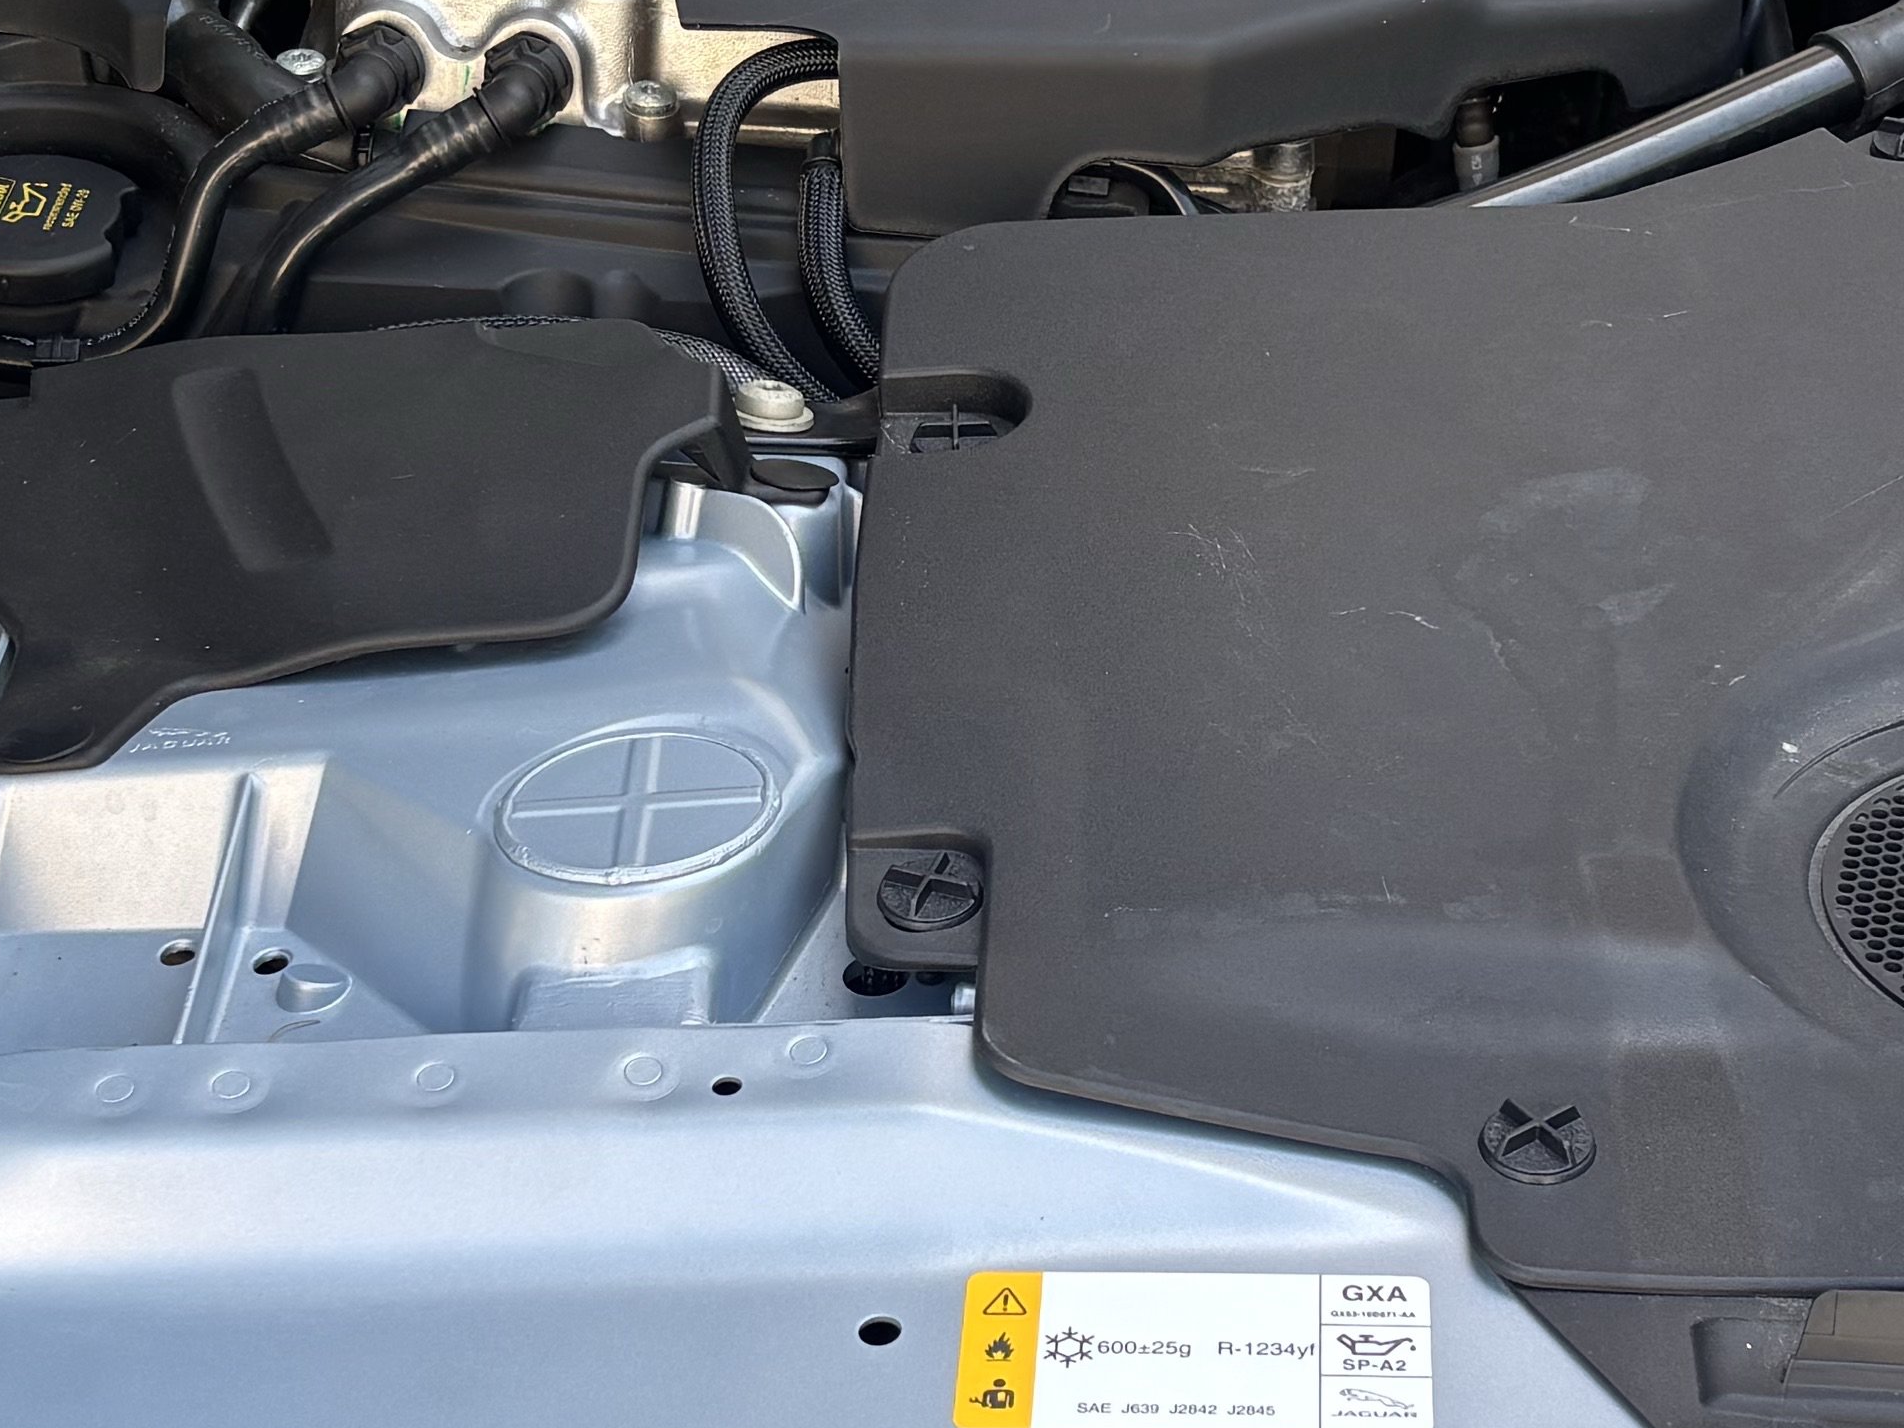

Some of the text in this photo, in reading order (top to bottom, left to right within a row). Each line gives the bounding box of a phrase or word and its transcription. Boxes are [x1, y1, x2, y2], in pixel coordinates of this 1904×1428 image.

[128, 735, 232, 754] JAGUAR
[1342, 1284, 1408, 1302] GXA
[1097, 1340, 1316, 1360] 600±25g R-1234yf
[1342, 1358, 1408, 1372] SP-A2
[1076, 1402, 1276, 1417] SAE J639 J2842 J2845
[1331, 1410, 1418, 1419] JAGUAR
